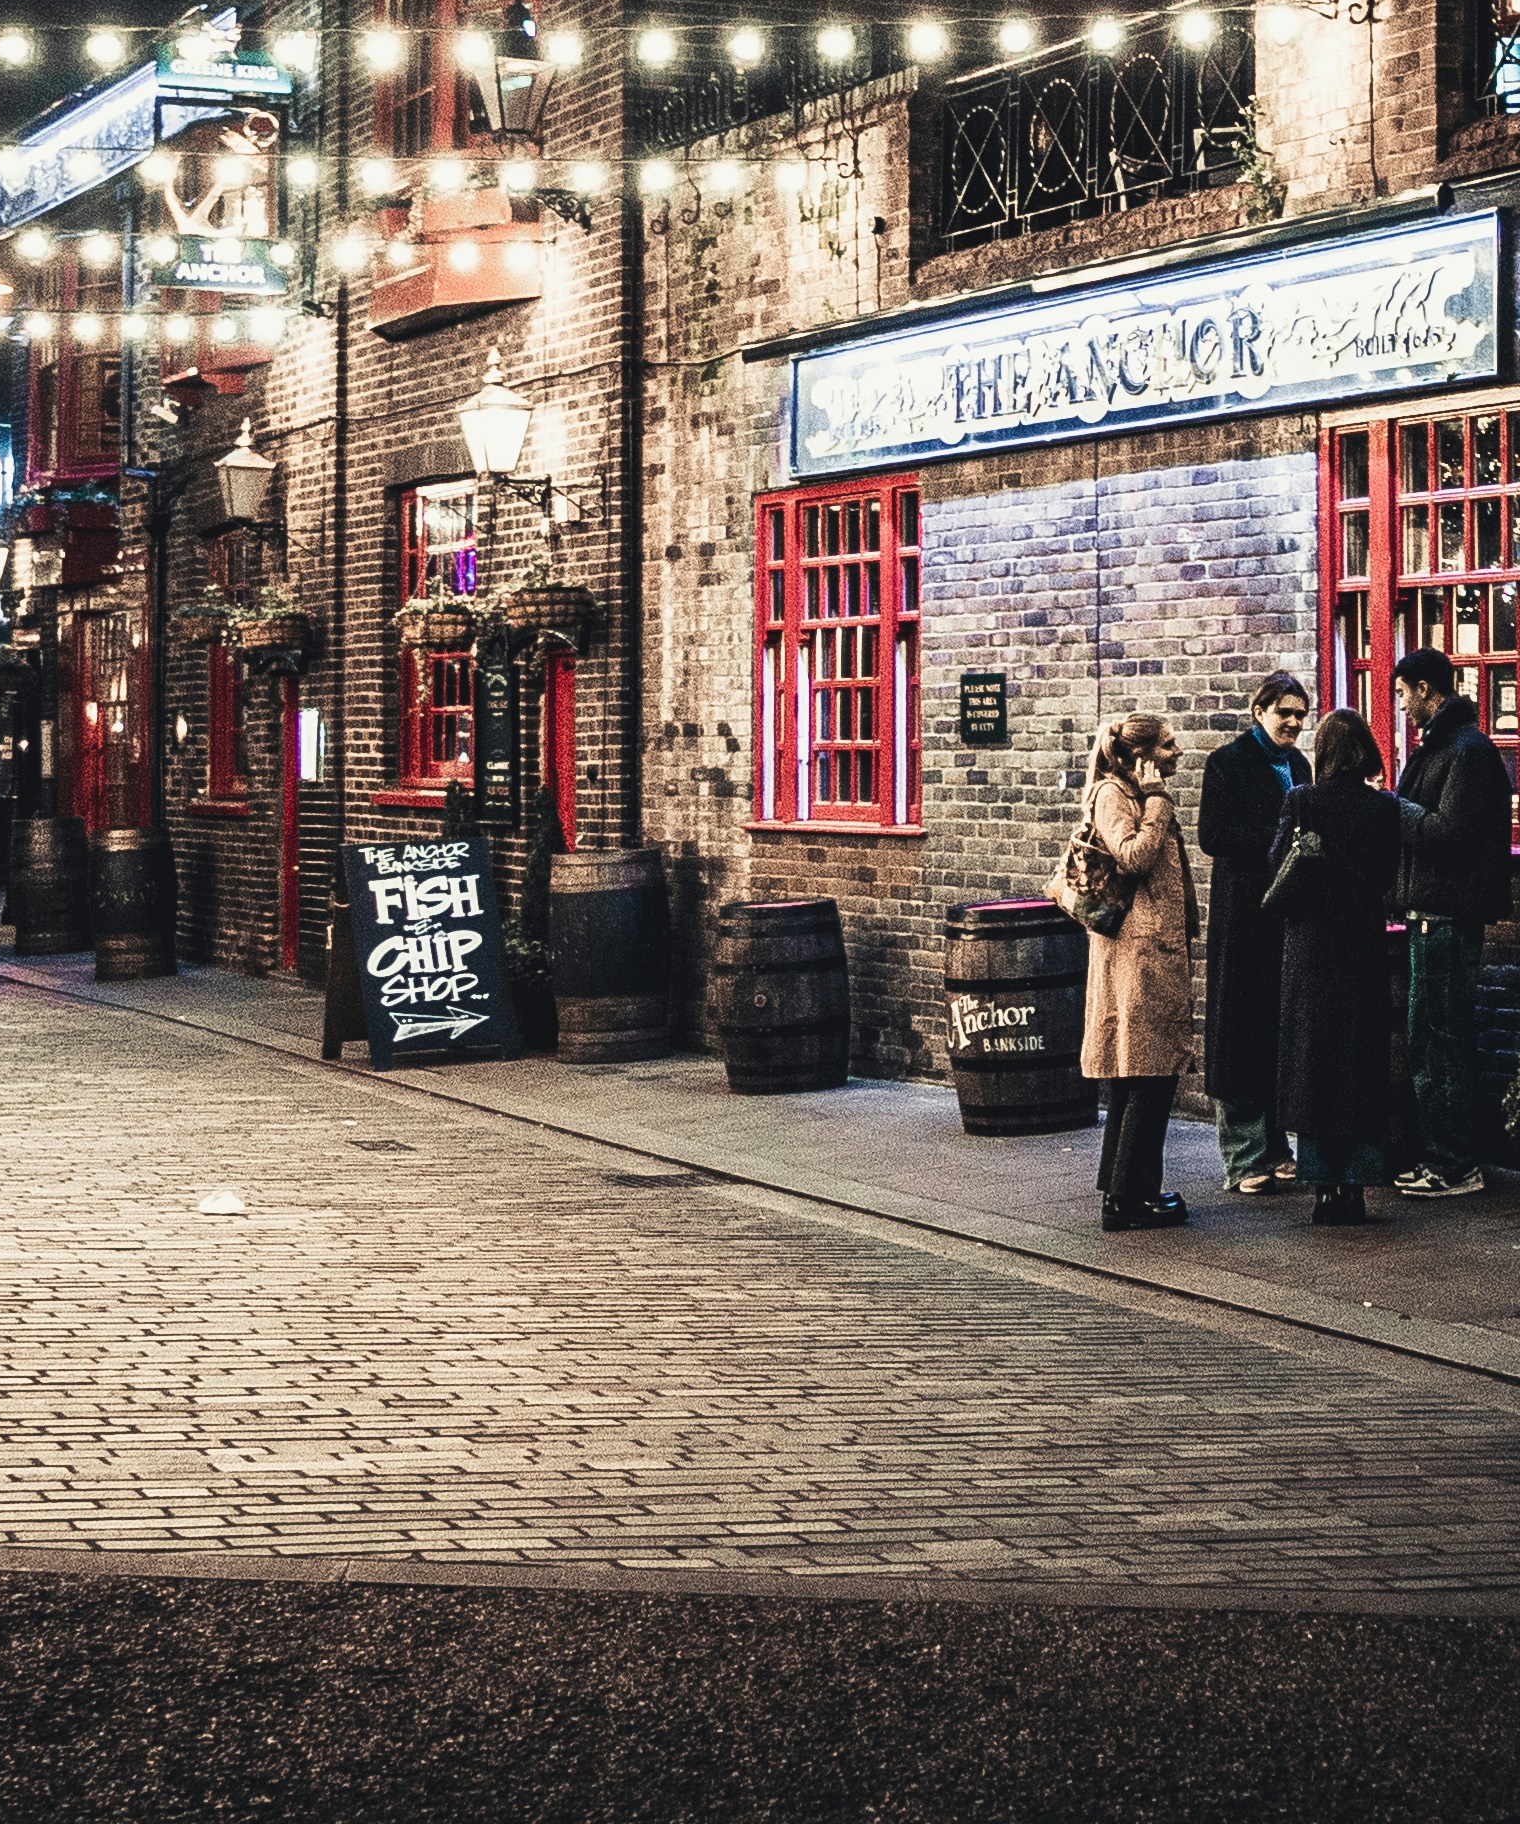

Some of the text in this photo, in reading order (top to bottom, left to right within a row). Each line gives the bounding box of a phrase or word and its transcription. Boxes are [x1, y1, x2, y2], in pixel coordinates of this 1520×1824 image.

[169, 59, 279, 81] GREENE KING
[176, 262, 267, 284] ANCHOR
[1046, 305, 1266, 408] ANCHOR
[359, 841, 471, 866] THE ANCHOR
[376, 856, 462, 875] BANKSIDE
[960, 994, 980, 1014] The
[946, 999, 1036, 1050] Anchor
[982, 1035, 1046, 1053] BANKSIDE
